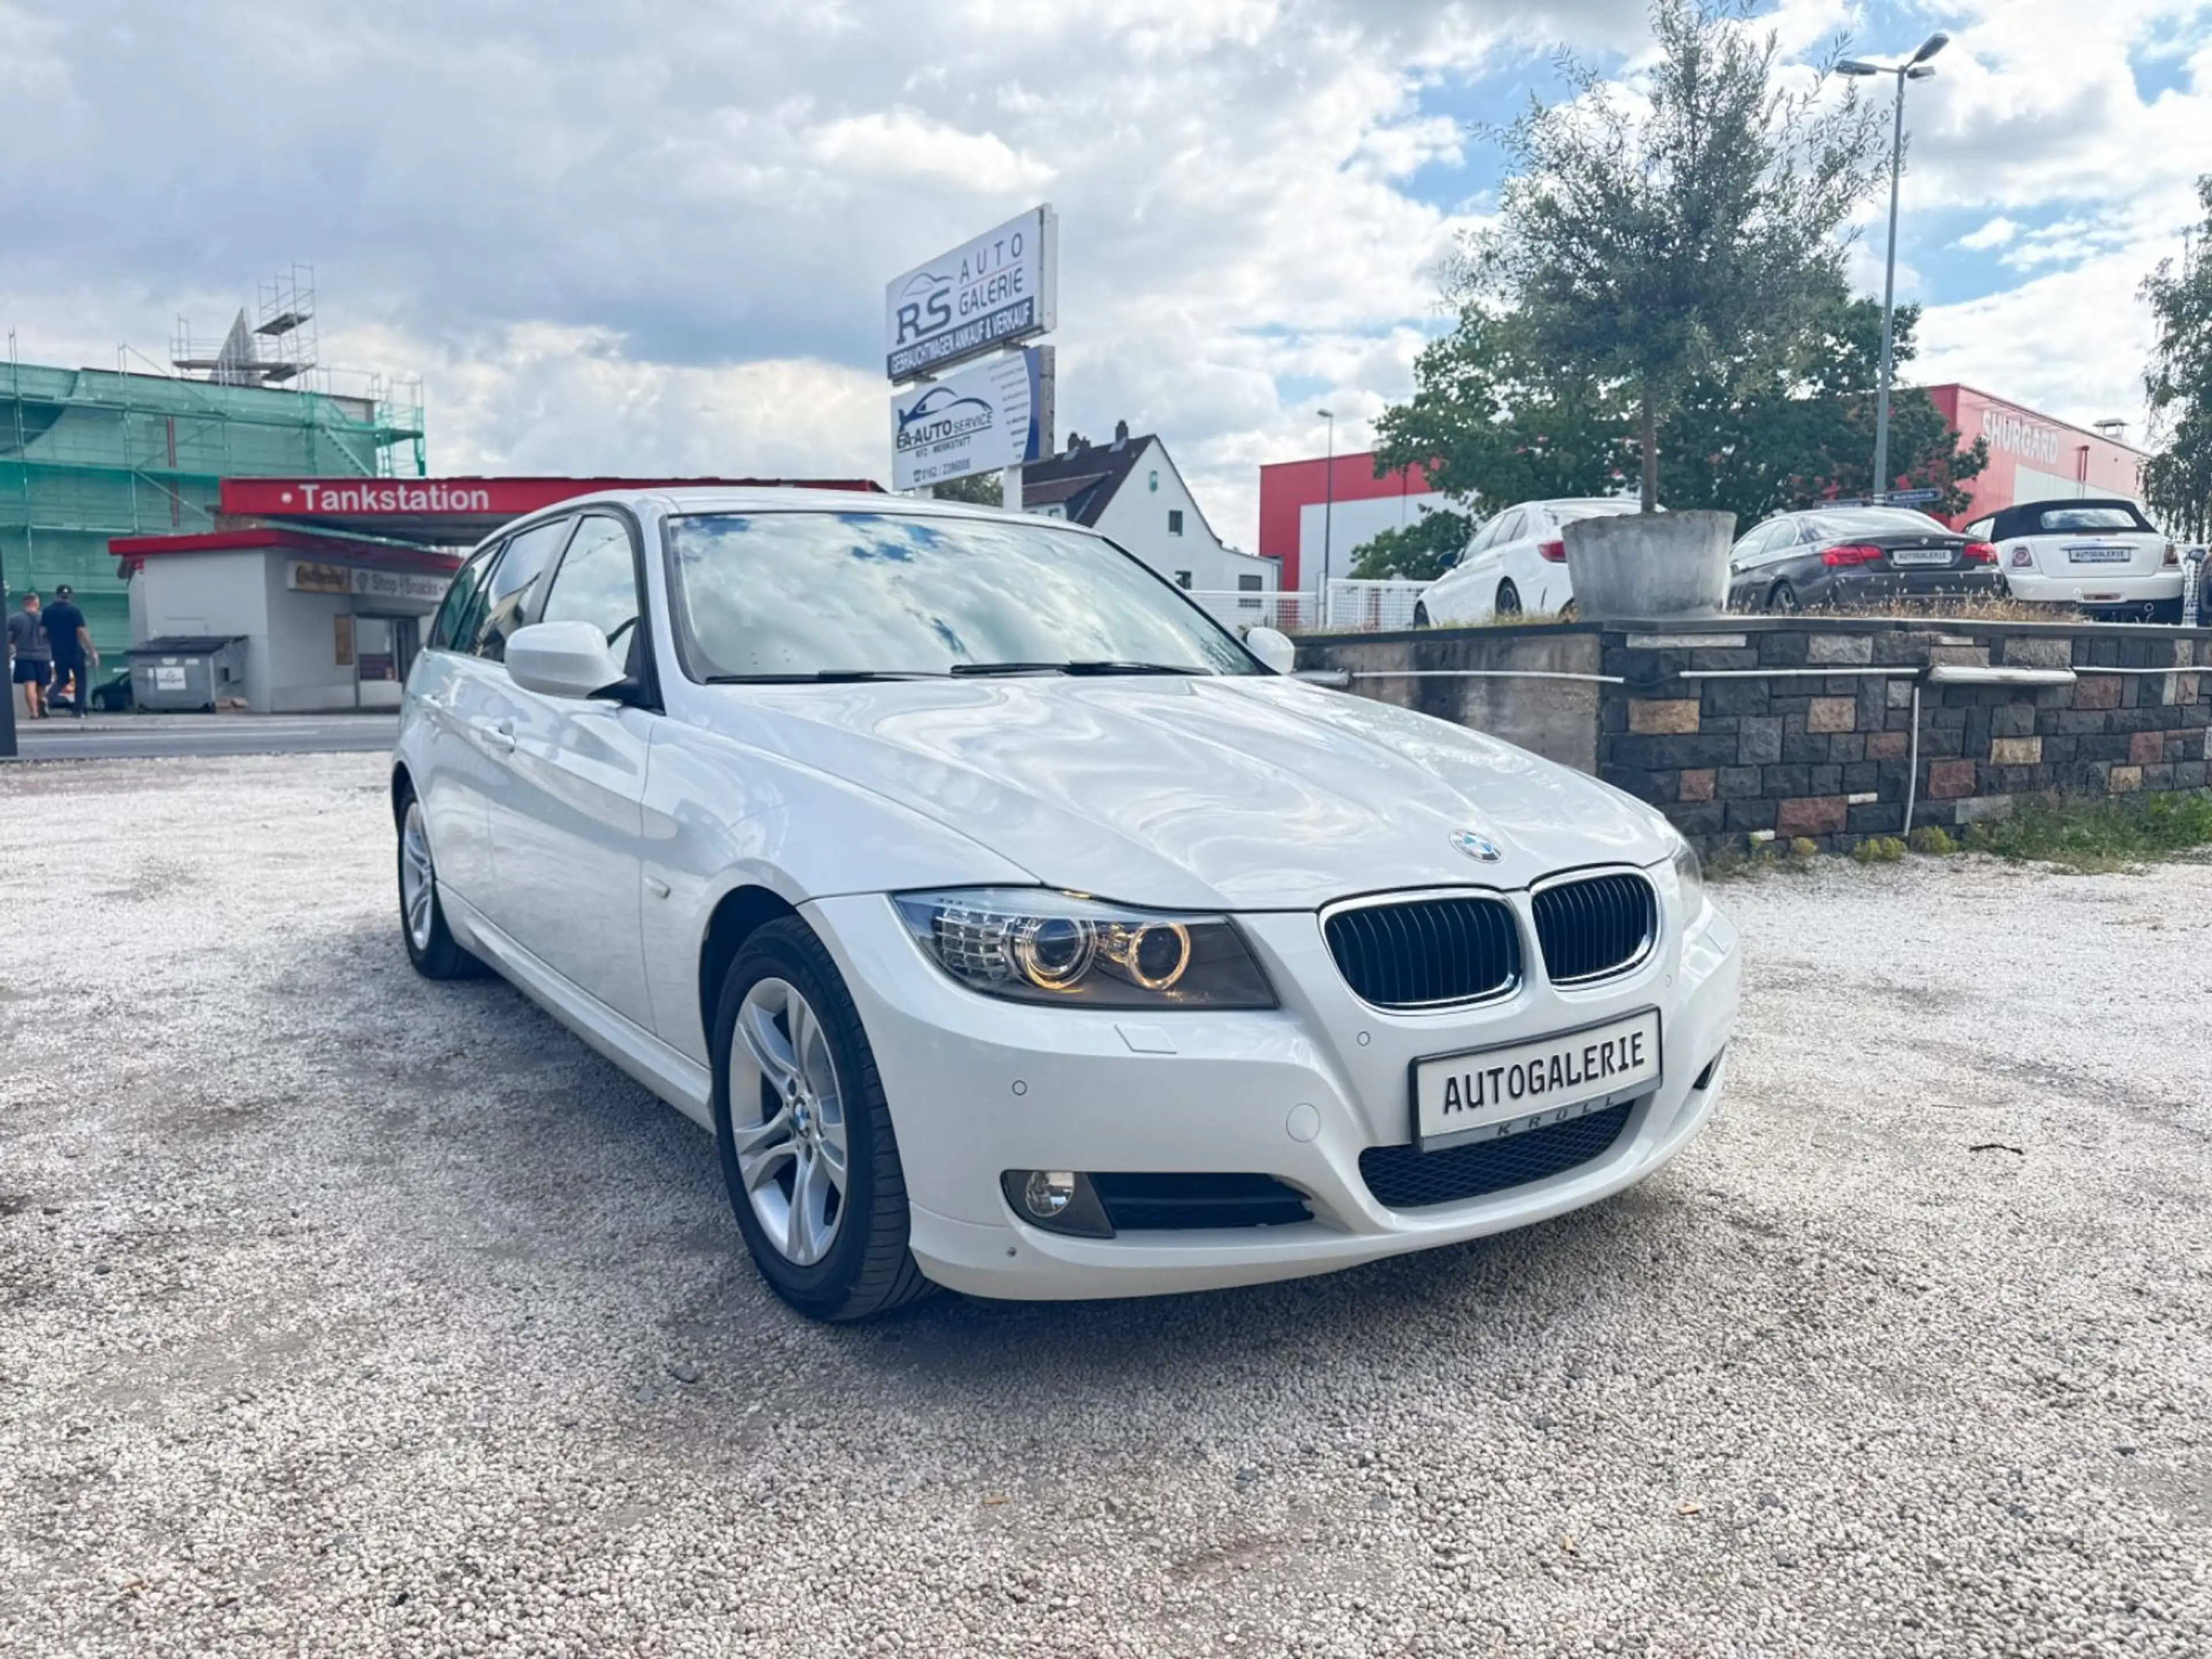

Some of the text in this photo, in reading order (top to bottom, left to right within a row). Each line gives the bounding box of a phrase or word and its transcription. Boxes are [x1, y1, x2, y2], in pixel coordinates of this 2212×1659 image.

[959, 232, 1022, 284] AUTO
[896, 287, 952, 344] RS
[959, 267, 1023, 316] GALERIE
[891, 334, 955, 375] GEBRAUCHTWAGEN
[955, 320, 984, 350] ANKAUF
[992, 301, 1031, 335] VERKAUF
[1982, 410, 2058, 464] SHURGARD
[298, 483, 490, 511] Tankstation
[1444, 1031, 1645, 1115] AUTOGALERIE
